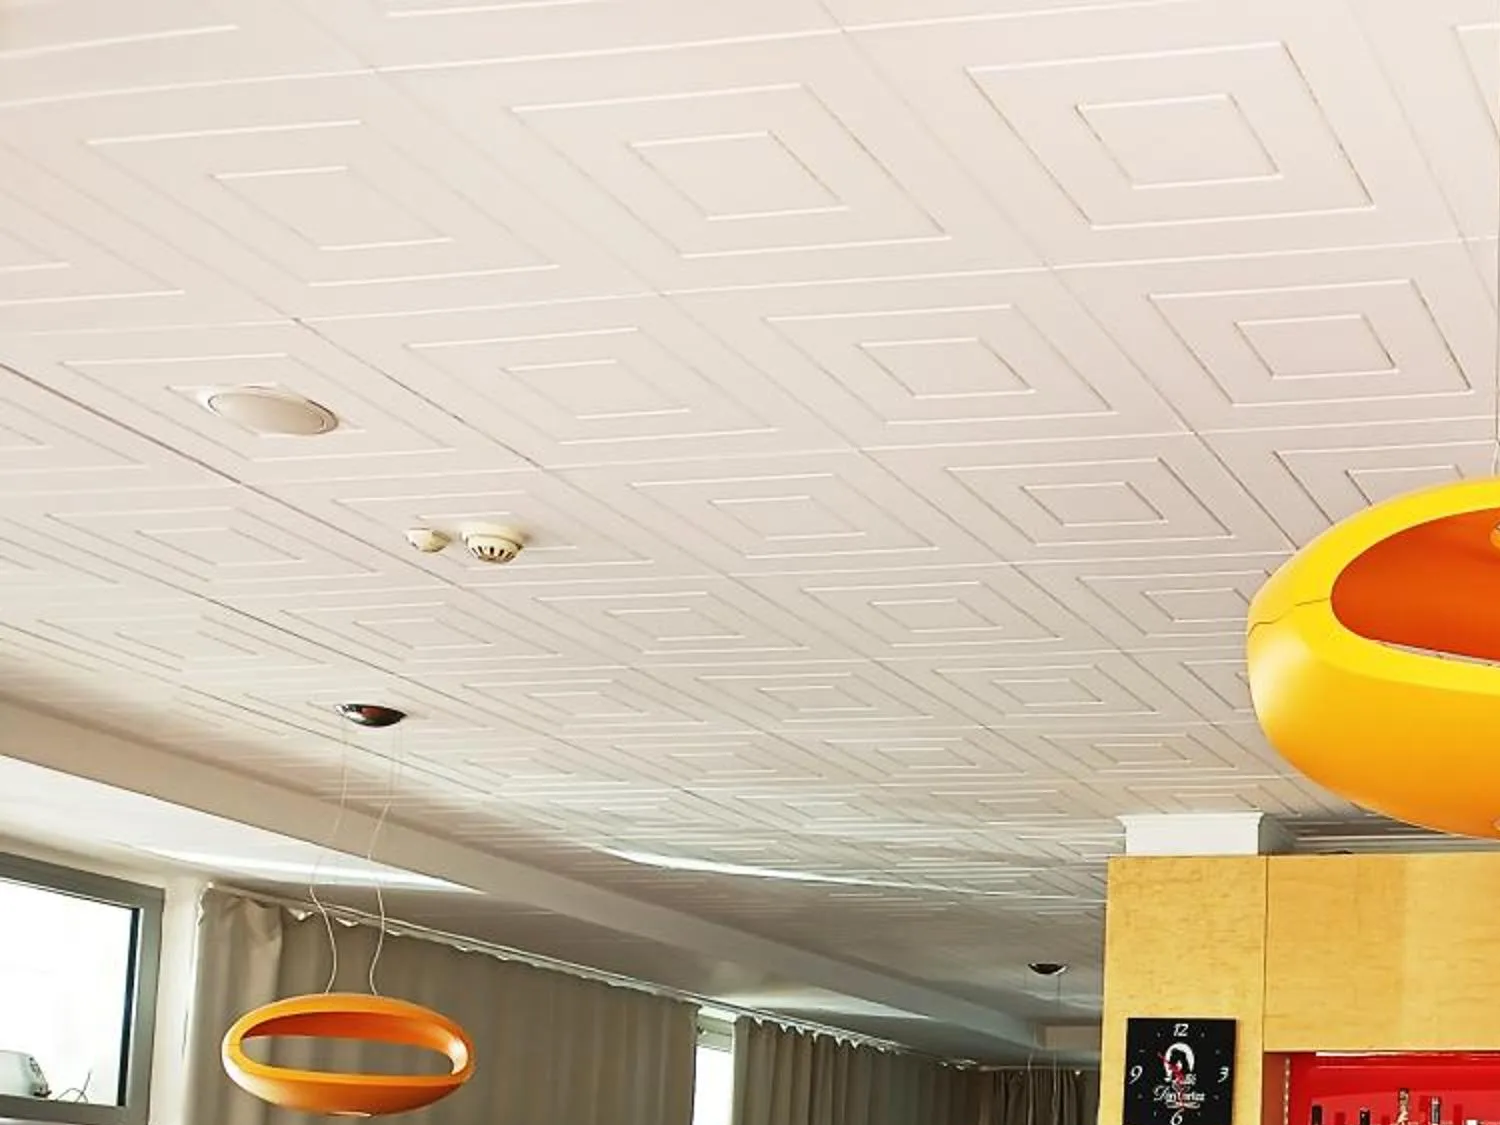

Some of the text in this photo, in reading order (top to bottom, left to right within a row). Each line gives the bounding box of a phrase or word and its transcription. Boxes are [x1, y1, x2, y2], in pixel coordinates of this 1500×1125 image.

[1173, 1023, 1189, 1037] 12
[1129, 1065, 1143, 1084] 9
[1217, 1066, 1229, 1083] 3
